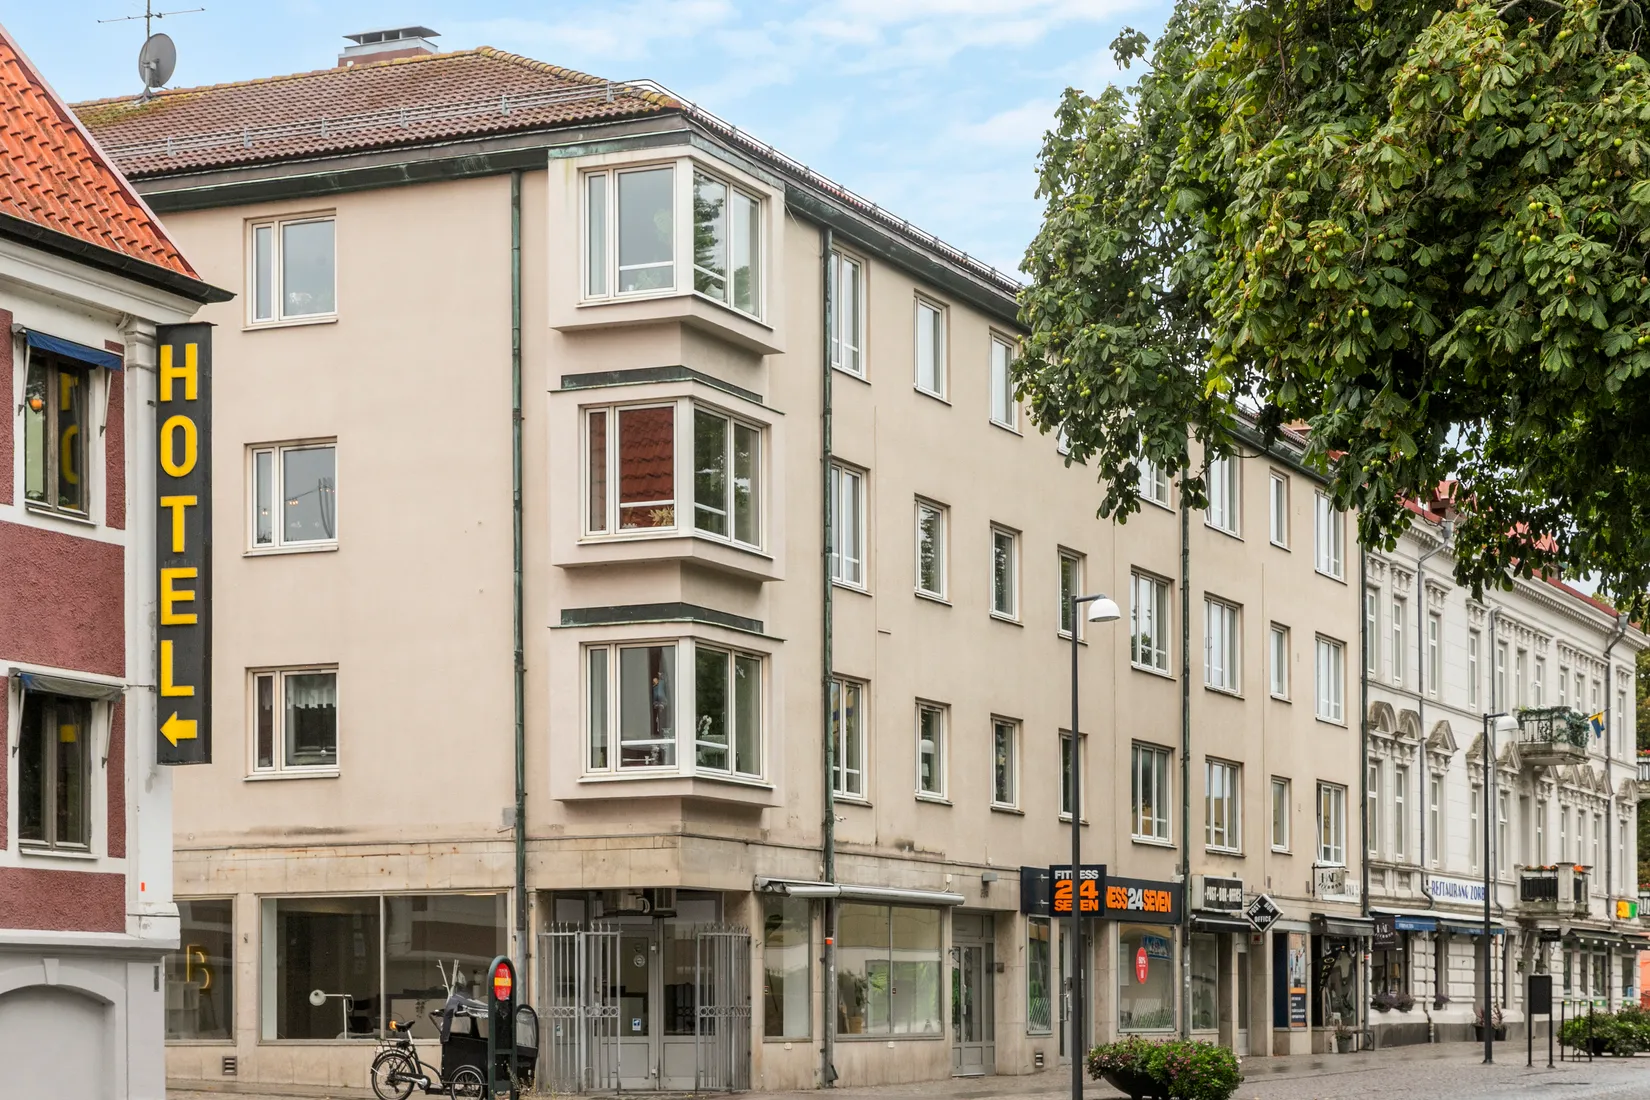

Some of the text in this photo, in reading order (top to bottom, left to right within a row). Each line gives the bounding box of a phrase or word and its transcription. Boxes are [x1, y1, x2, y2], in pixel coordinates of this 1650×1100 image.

[160, 343, 198, 696] HOTEL
[1054, 870, 1099, 879] FITESS
[1054, 880, 1099, 899] 24
[1431, 880, 1469, 900] RESTAURANG
[1054, 900, 1099, 911] SEEN
[1127, 888, 1143, 910] 24
[1143, 889, 1172, 912] SEVEN
[1248, 902, 1261, 916] POST
